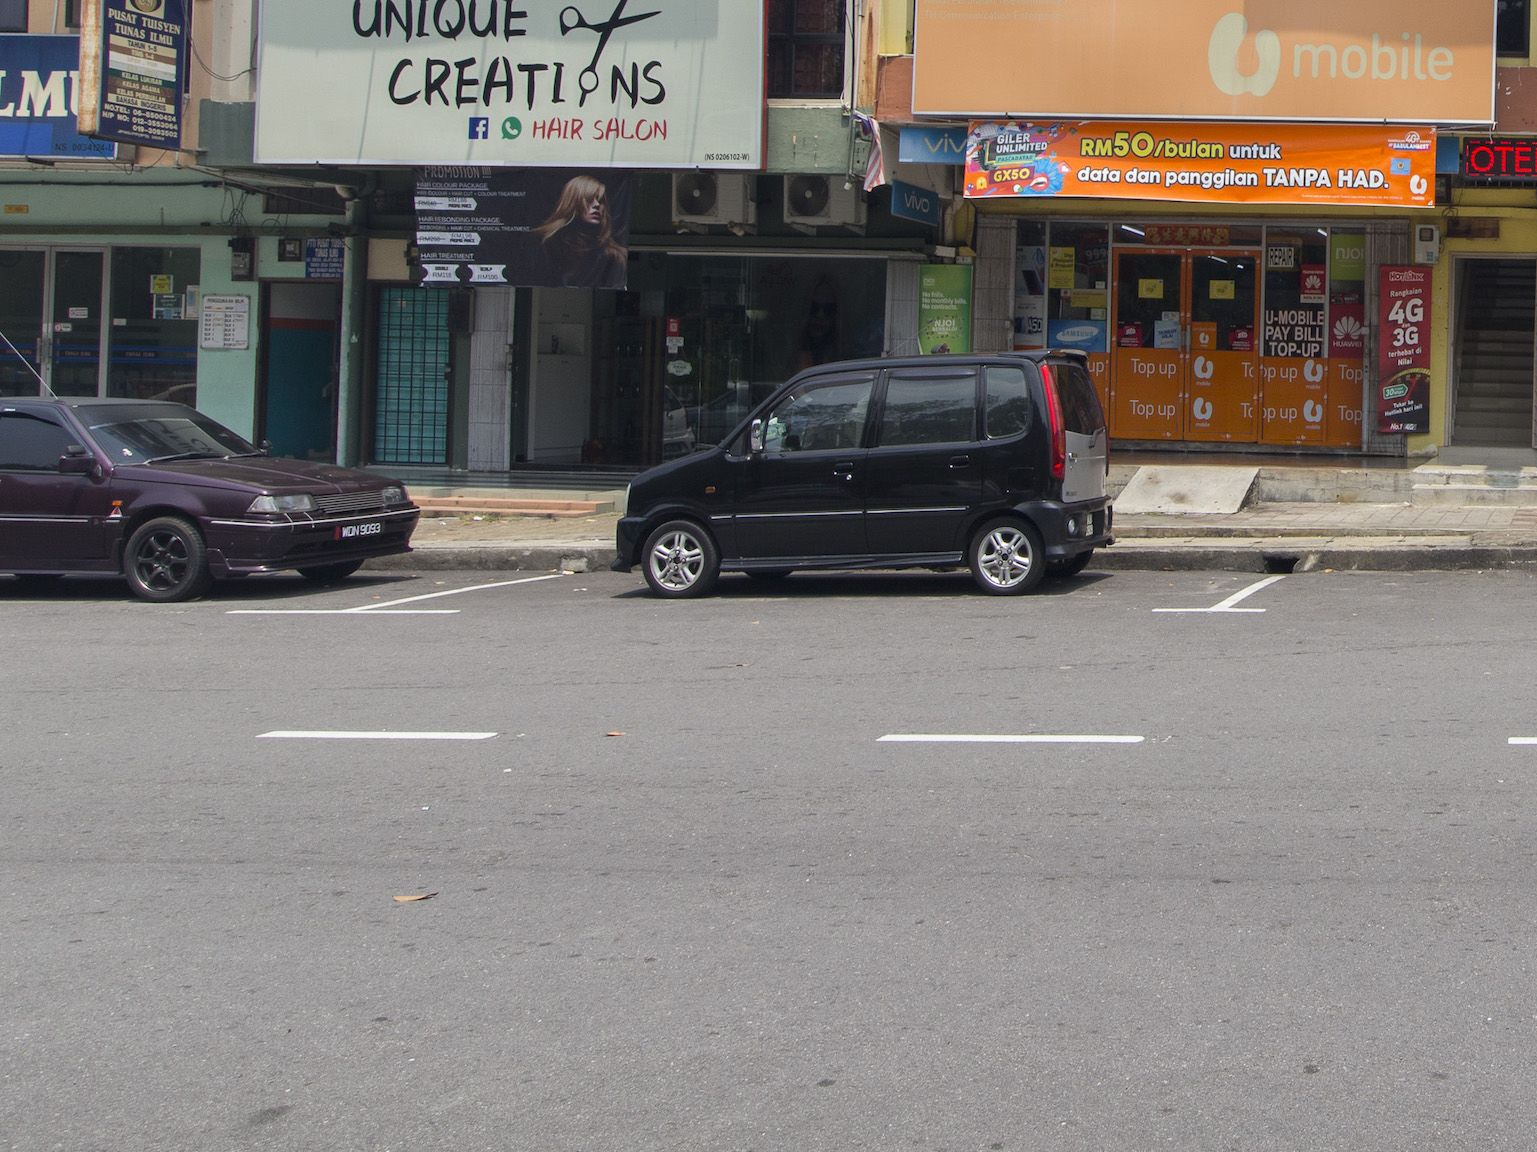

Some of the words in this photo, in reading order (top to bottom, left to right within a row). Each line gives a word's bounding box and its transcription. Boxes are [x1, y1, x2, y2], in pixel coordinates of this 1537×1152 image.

[108, 8, 138, 24] PUSAT
[141, 16, 181, 35] TUISYEN
[115, 23, 146, 39] TUNAS
[150, 32, 173, 46] ILMU
[1293, 33, 1454, 81] mobile
[0, 71, 80, 117] LM
[532, 118, 584, 141] HAIR
[593, 118, 667, 141] SALON
[997, 132, 1030, 144] GILER
[924, 133, 968, 154] viv
[996, 142, 1048, 153] UNLIMITED
[1081, 131, 1224, 159] RM50/bulan
[1229, 143, 1282, 160] untuk
[993, 168, 1030, 182] GX50
[1077, 166, 1121, 183] data
[1125, 167, 1161, 184] dan
[1164, 168, 1258, 189] panggilan
[1262, 168, 1332, 188] TANPA
[1337, 169, 1390, 189] HAD.
[904, 192, 930, 214] vivo
[1270, 247, 1294, 266] REPAIR
[1390, 288, 1423, 298] Rangkaian
[1265, 310, 1324, 326] U-MOBILE
[1388, 298, 1424, 324] 4G
[1265, 326, 1290, 341] PAY
[1294, 327, 1324, 341] BILL
[1392, 326, 1419, 346] 3G
[1269, 342, 1320, 357] TOP-UP
[1131, 359, 1156, 377] Top
[1159, 361, 1176, 377] up
[1280, 365, 1298, 380] up
[1338, 364, 1363, 382] Top
[1129, 400, 1154, 418] Top
[1158, 403, 1175, 419] up
[1279, 406, 1297, 422] up
[1337, 405, 1362, 423] Top
[360, 522, 381, 535] 9093
